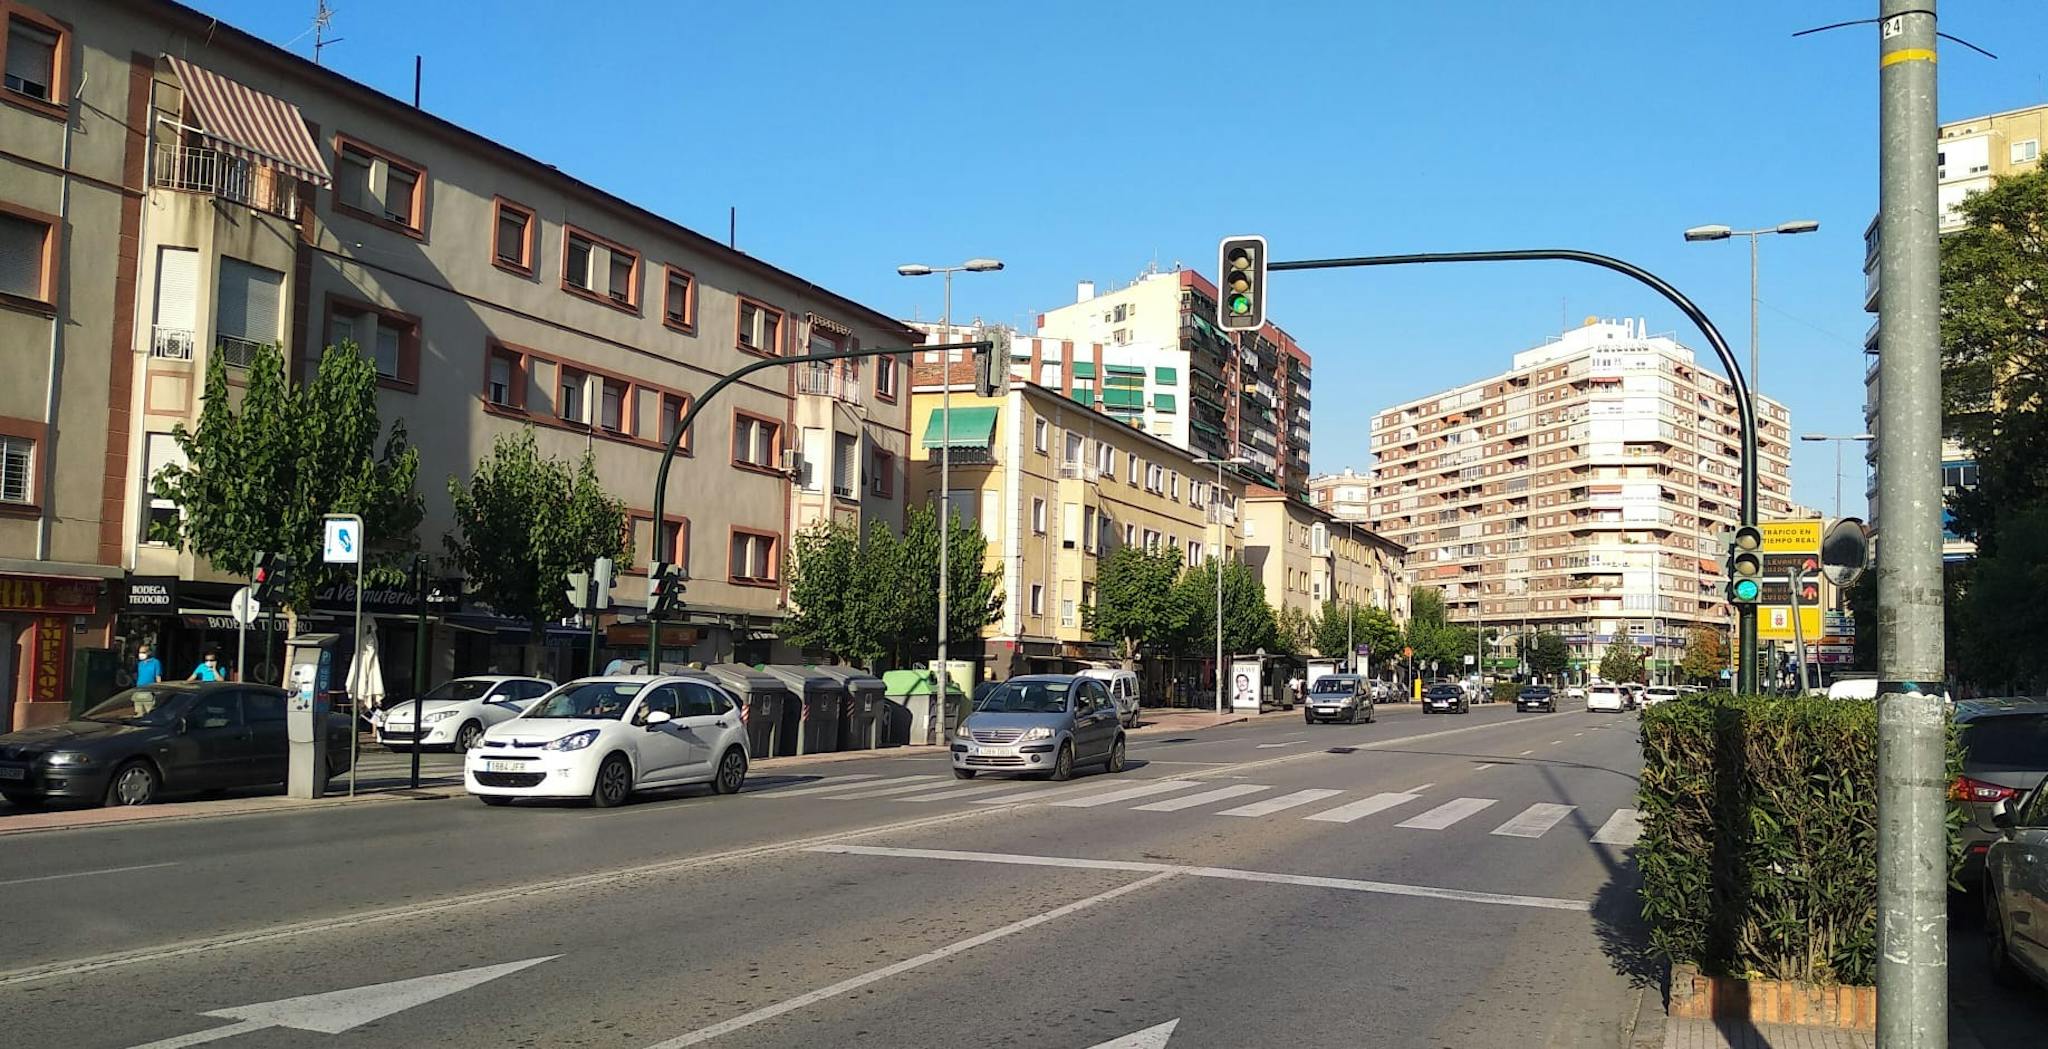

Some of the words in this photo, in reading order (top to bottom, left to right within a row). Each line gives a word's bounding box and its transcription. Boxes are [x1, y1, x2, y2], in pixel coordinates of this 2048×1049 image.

[1885, 19, 1900, 36] 24
[132, 585, 167, 595] BODEGA
[337, 584, 416, 605] Vemuteria
[129, 595, 170, 605] TEODORO
[208, 616, 256, 631] BODEA
